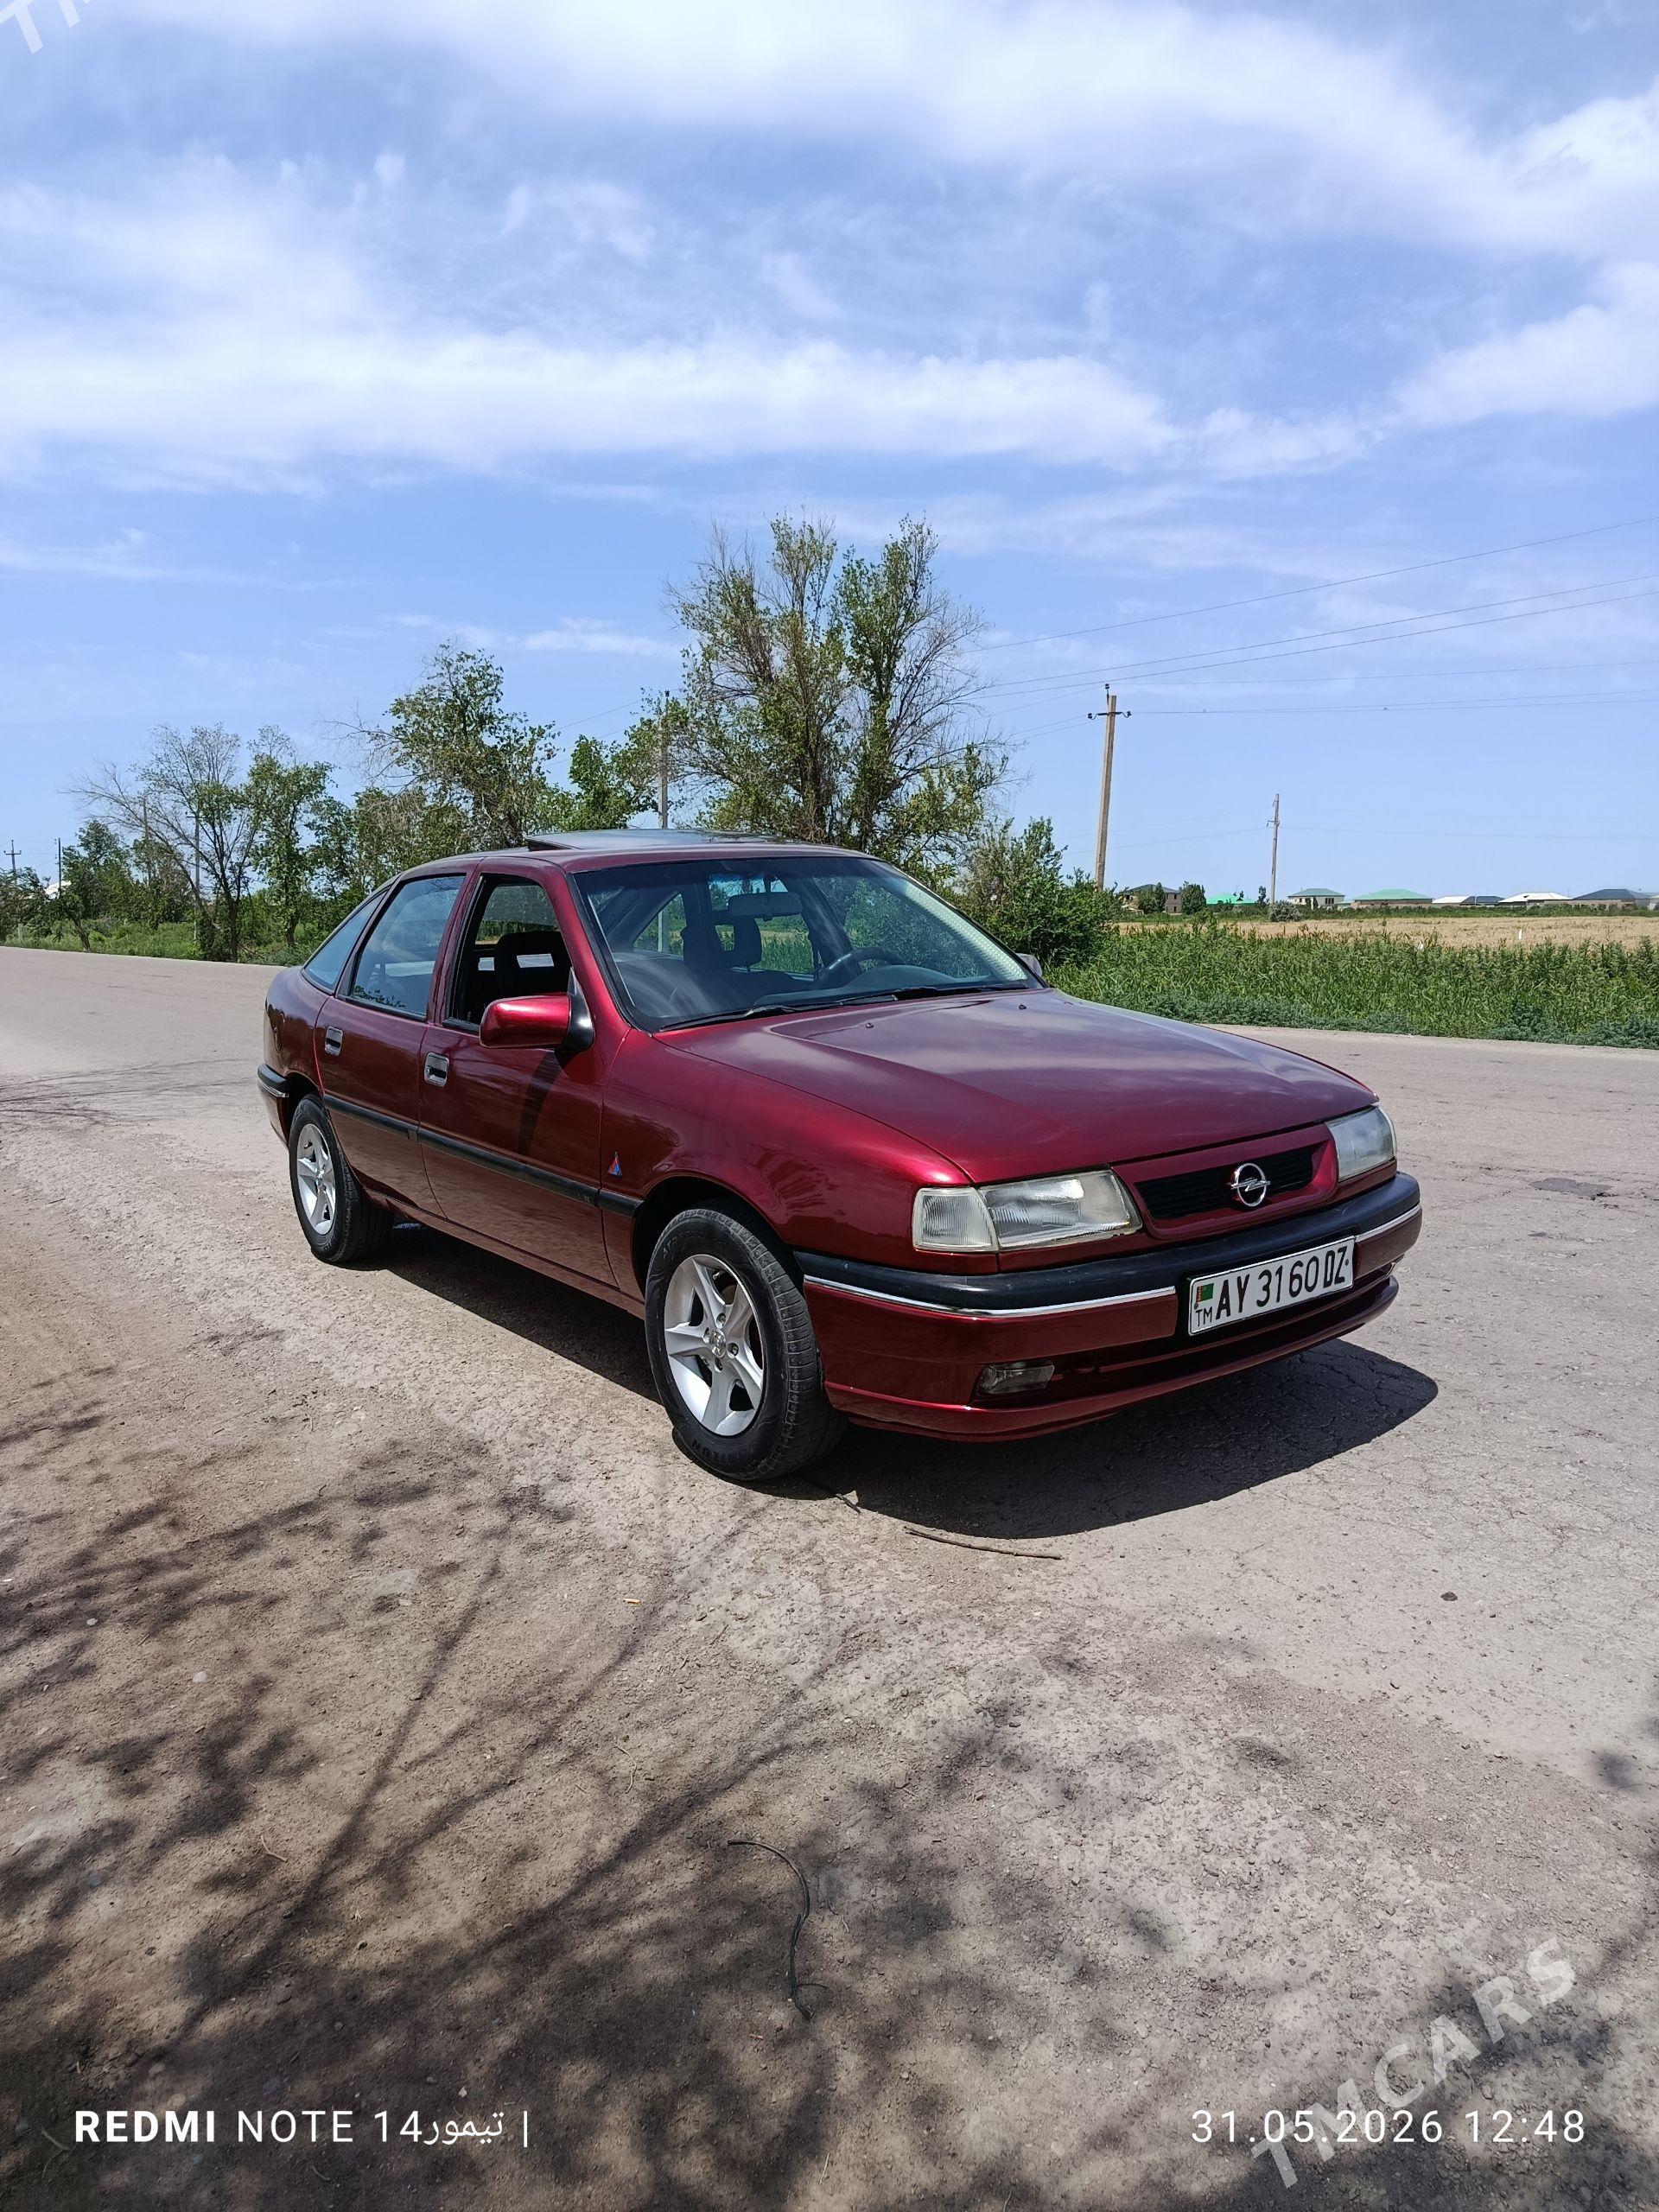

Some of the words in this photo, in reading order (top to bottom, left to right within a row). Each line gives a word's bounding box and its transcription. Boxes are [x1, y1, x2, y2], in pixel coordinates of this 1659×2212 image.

[1216, 1274, 1250, 1319] AY
[1256, 1255, 1319, 1307] 3160
[1323, 1246, 1348, 1288] DZ
[1196, 1308, 1213, 1326] TM
